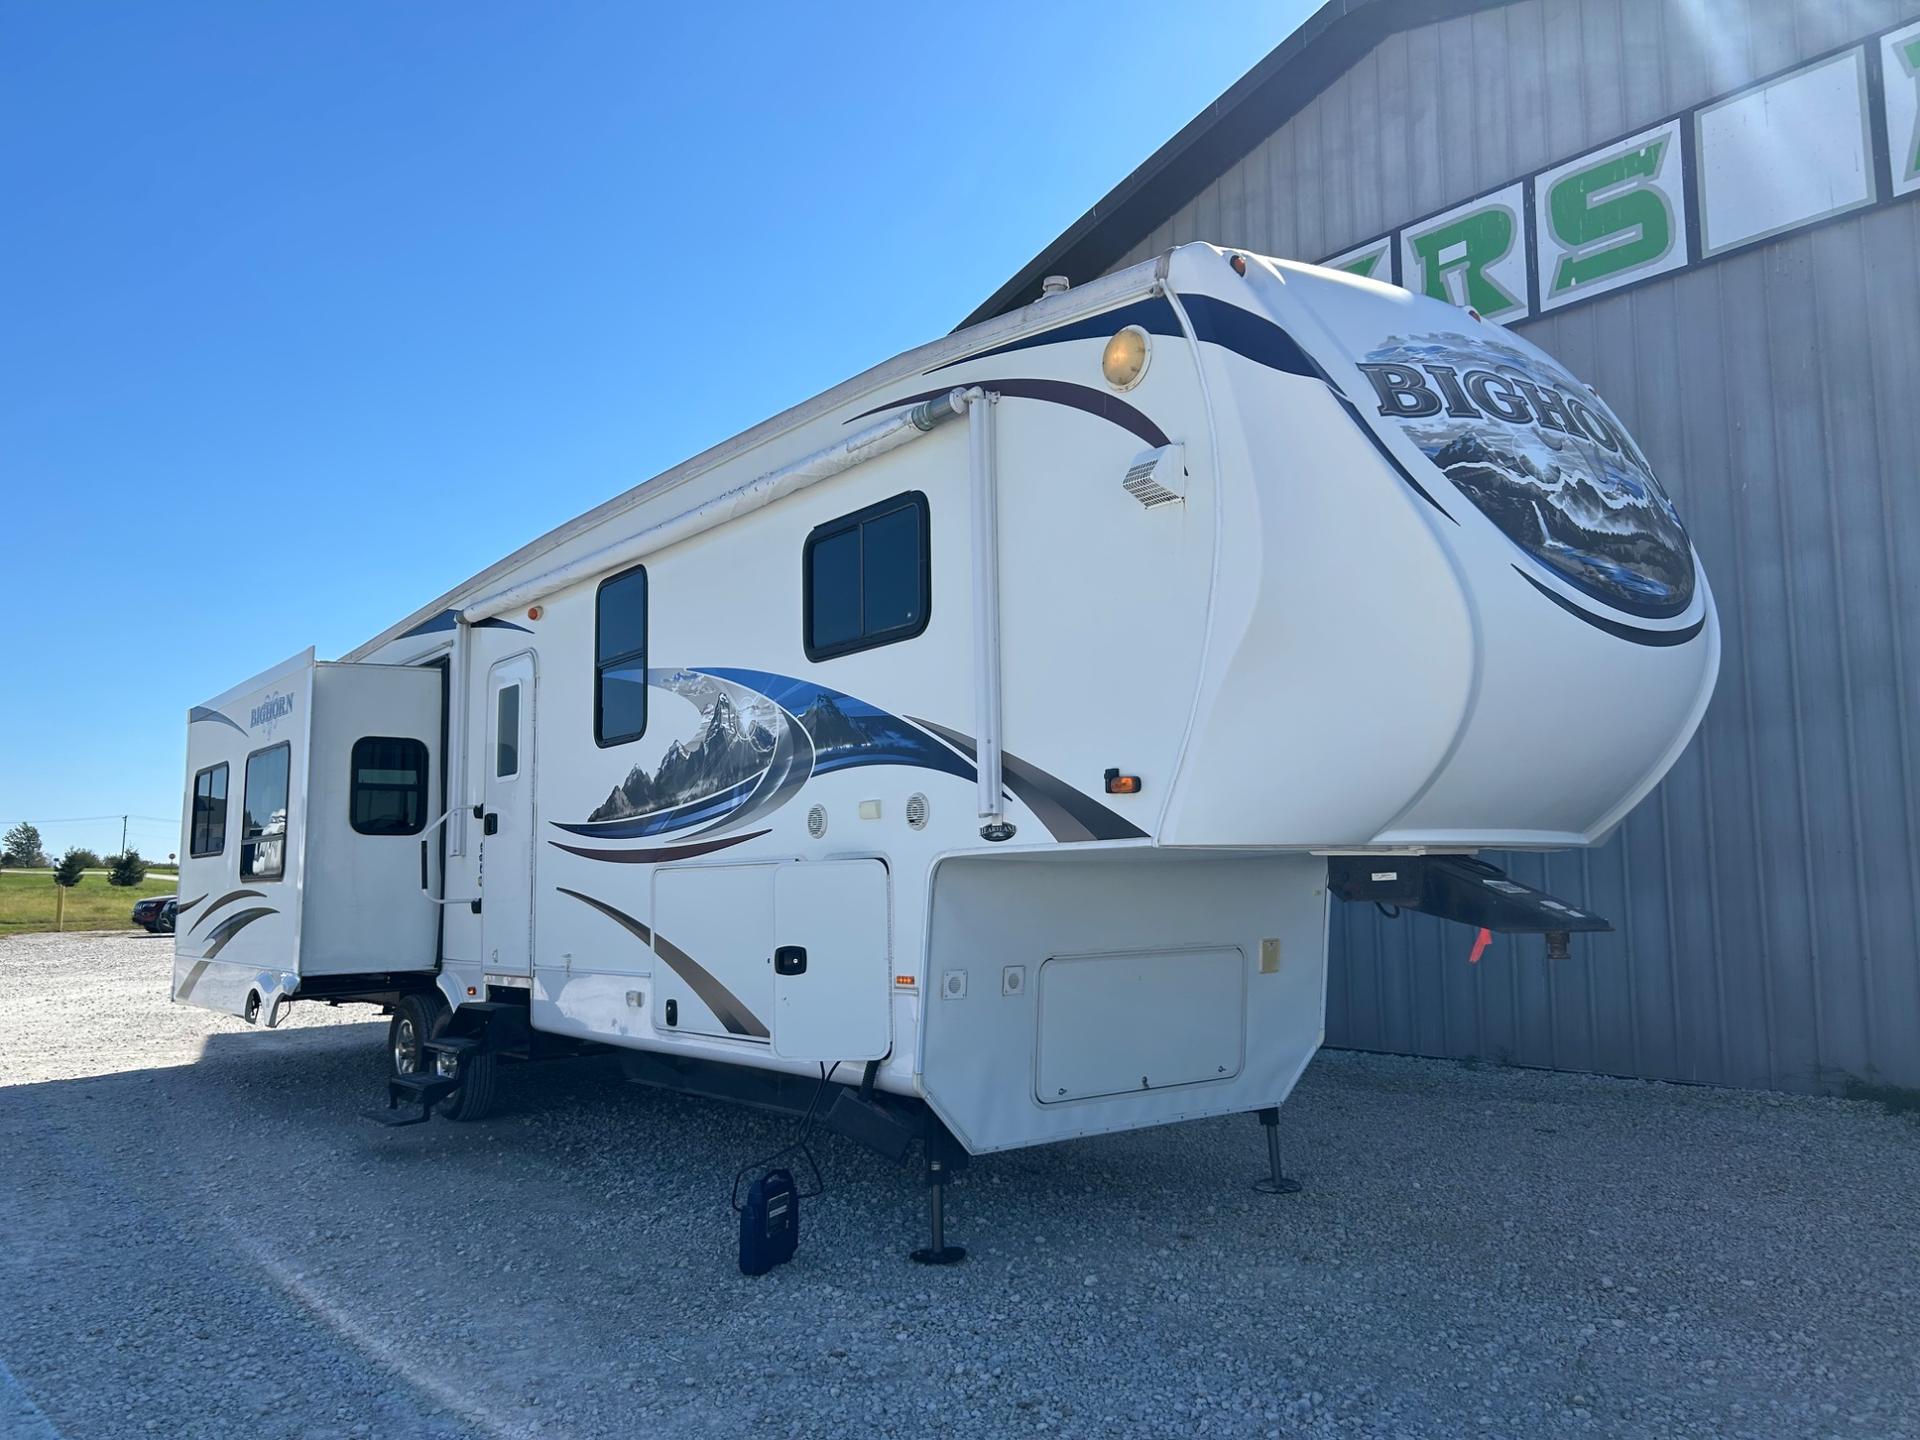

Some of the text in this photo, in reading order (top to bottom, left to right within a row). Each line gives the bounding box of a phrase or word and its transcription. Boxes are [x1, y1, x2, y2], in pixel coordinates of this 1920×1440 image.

[1332, 133, 1674, 317] RS
[1356, 362, 1640, 472] BIGHO
[250, 692, 294, 728] BIGHORN
